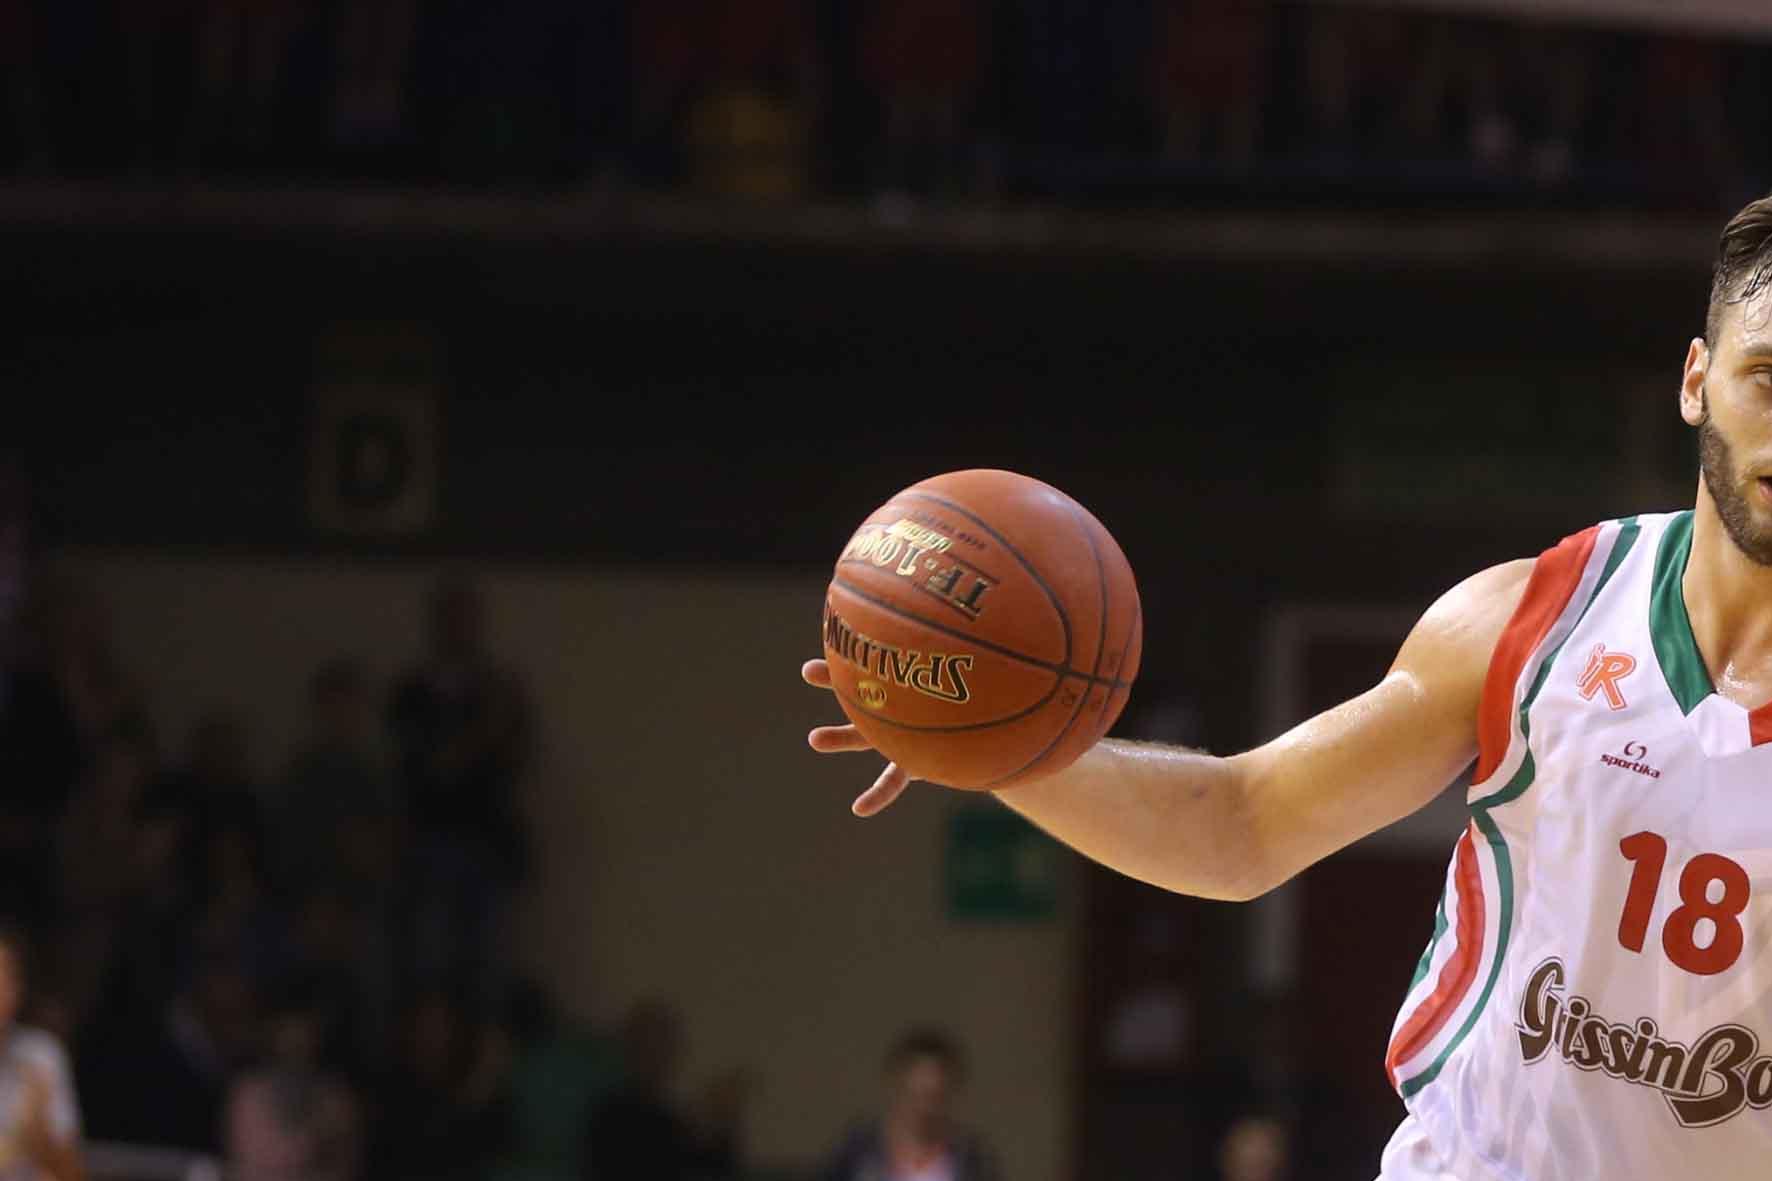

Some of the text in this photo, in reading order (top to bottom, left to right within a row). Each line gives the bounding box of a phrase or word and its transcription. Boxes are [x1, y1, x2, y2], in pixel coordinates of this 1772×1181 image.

[824, 598, 973, 703] SPALDIN
[1601, 752, 1661, 780] sportika
[1618, 830, 1751, 976] 18
